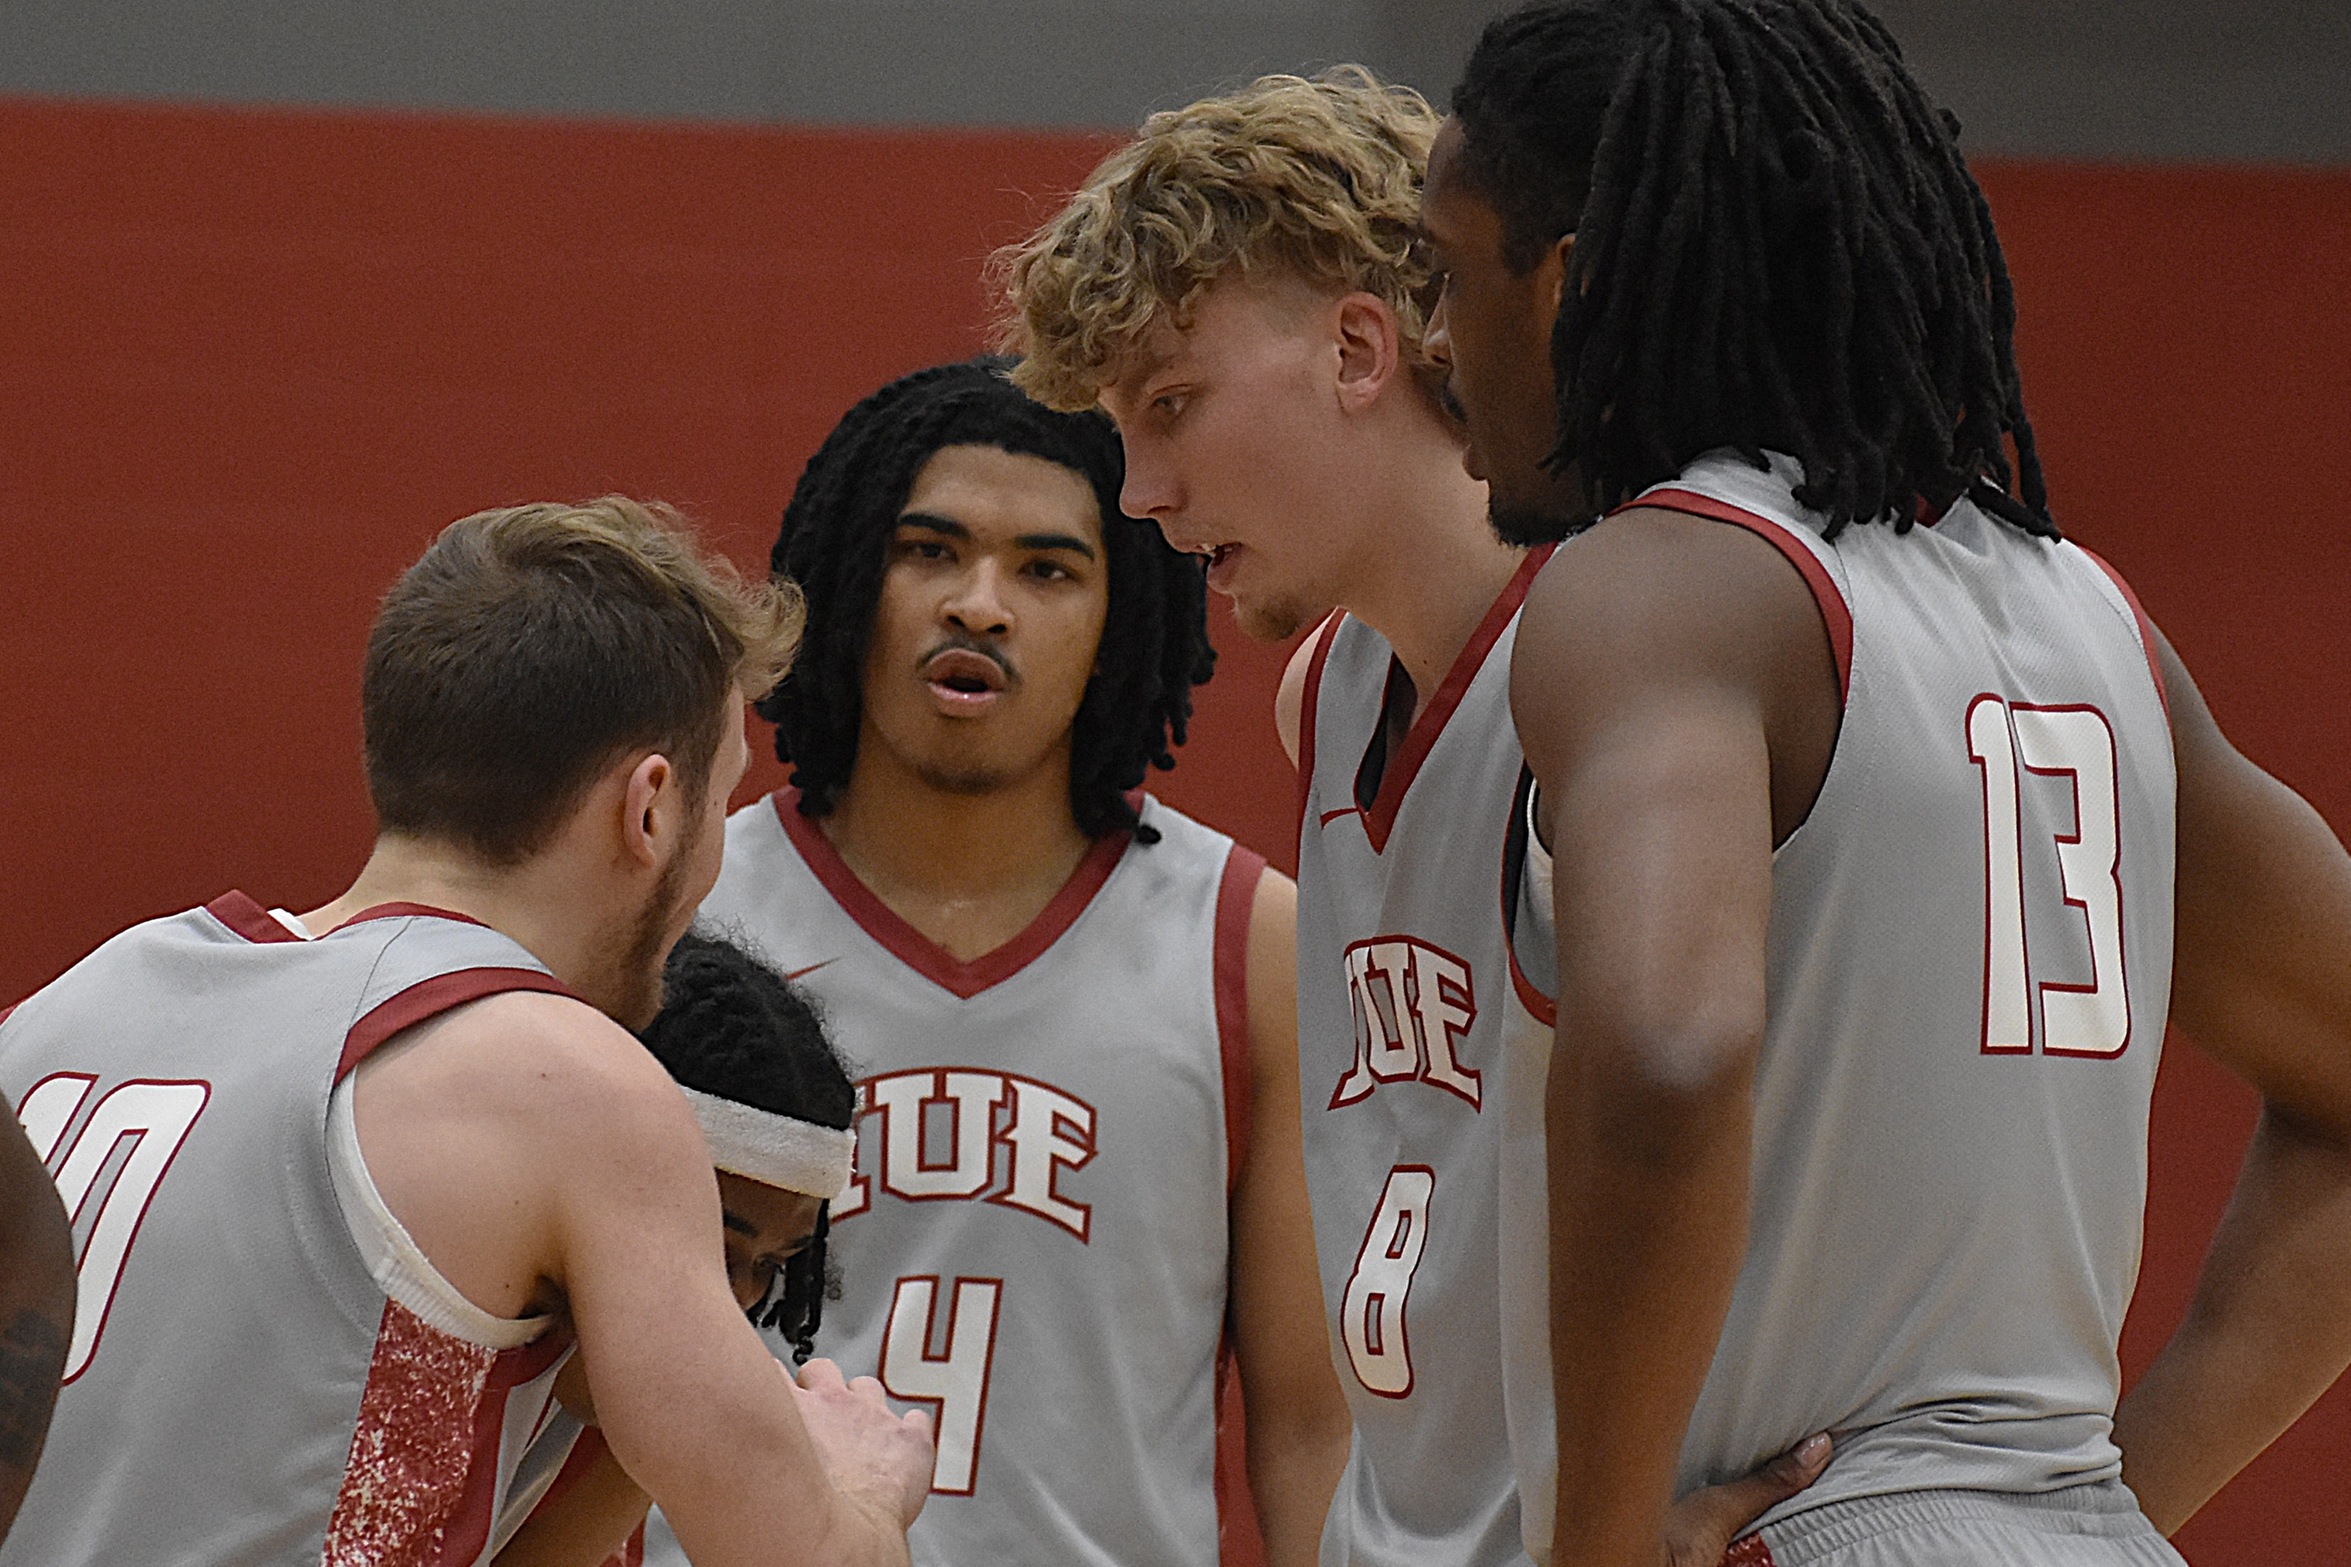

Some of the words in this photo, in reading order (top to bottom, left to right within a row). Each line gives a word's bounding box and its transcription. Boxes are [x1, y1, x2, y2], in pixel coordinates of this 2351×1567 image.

[1965, 692, 2131, 1060] 13
[877, 1274, 1003, 1497] 4
[1340, 1164, 1435, 1399] 8
